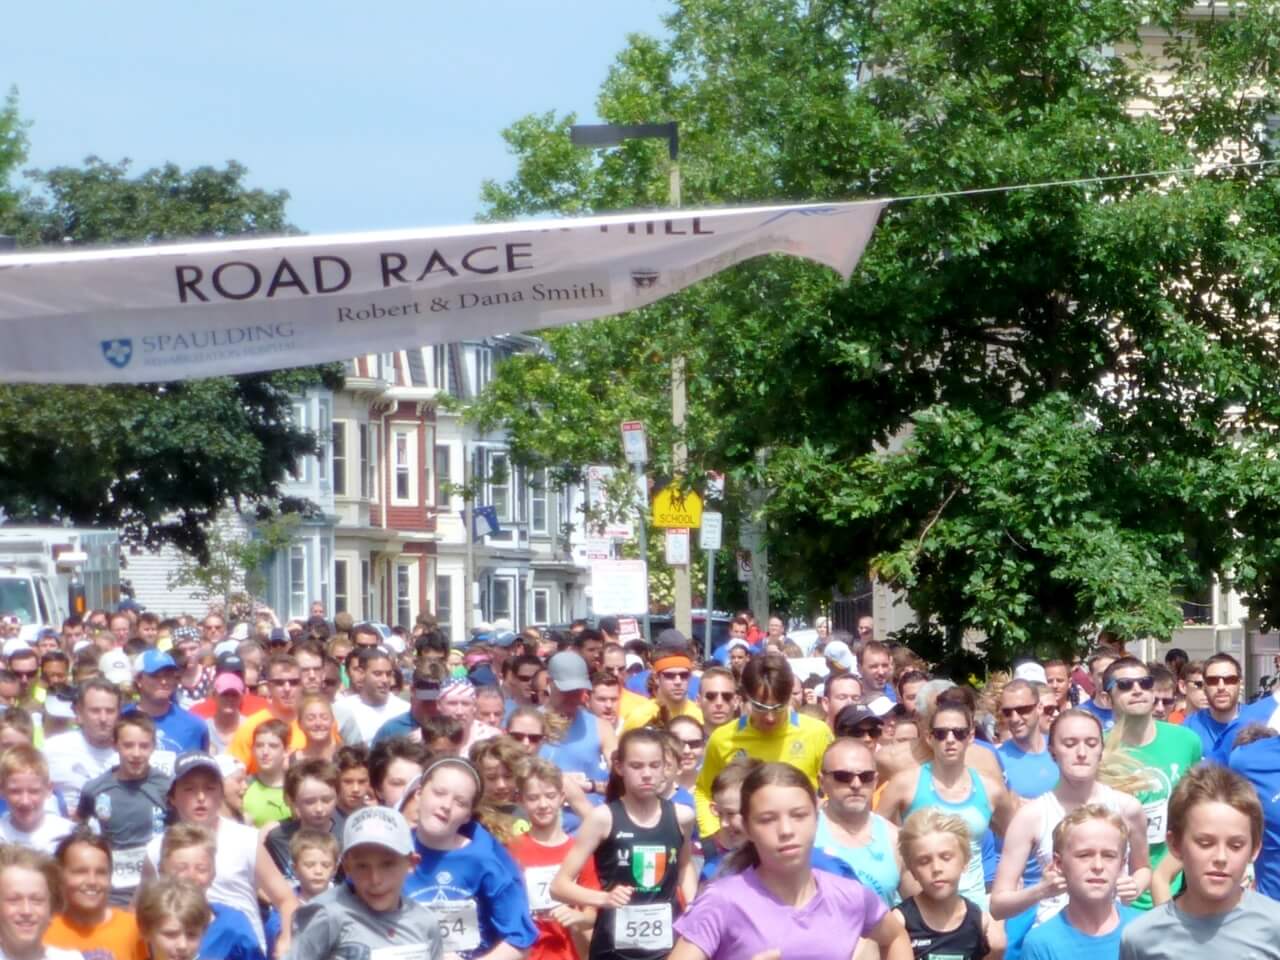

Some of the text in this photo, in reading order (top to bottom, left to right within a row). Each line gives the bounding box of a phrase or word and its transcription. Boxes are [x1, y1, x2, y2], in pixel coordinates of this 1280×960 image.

[175, 242, 534, 303] ROAD RACE
[337, 282, 605, 322] Robert & Dana Smith
[142, 321, 295, 352] SPAULDING
[660, 513, 695, 524] SCHOOL
[626, 920, 664, 937] 528
